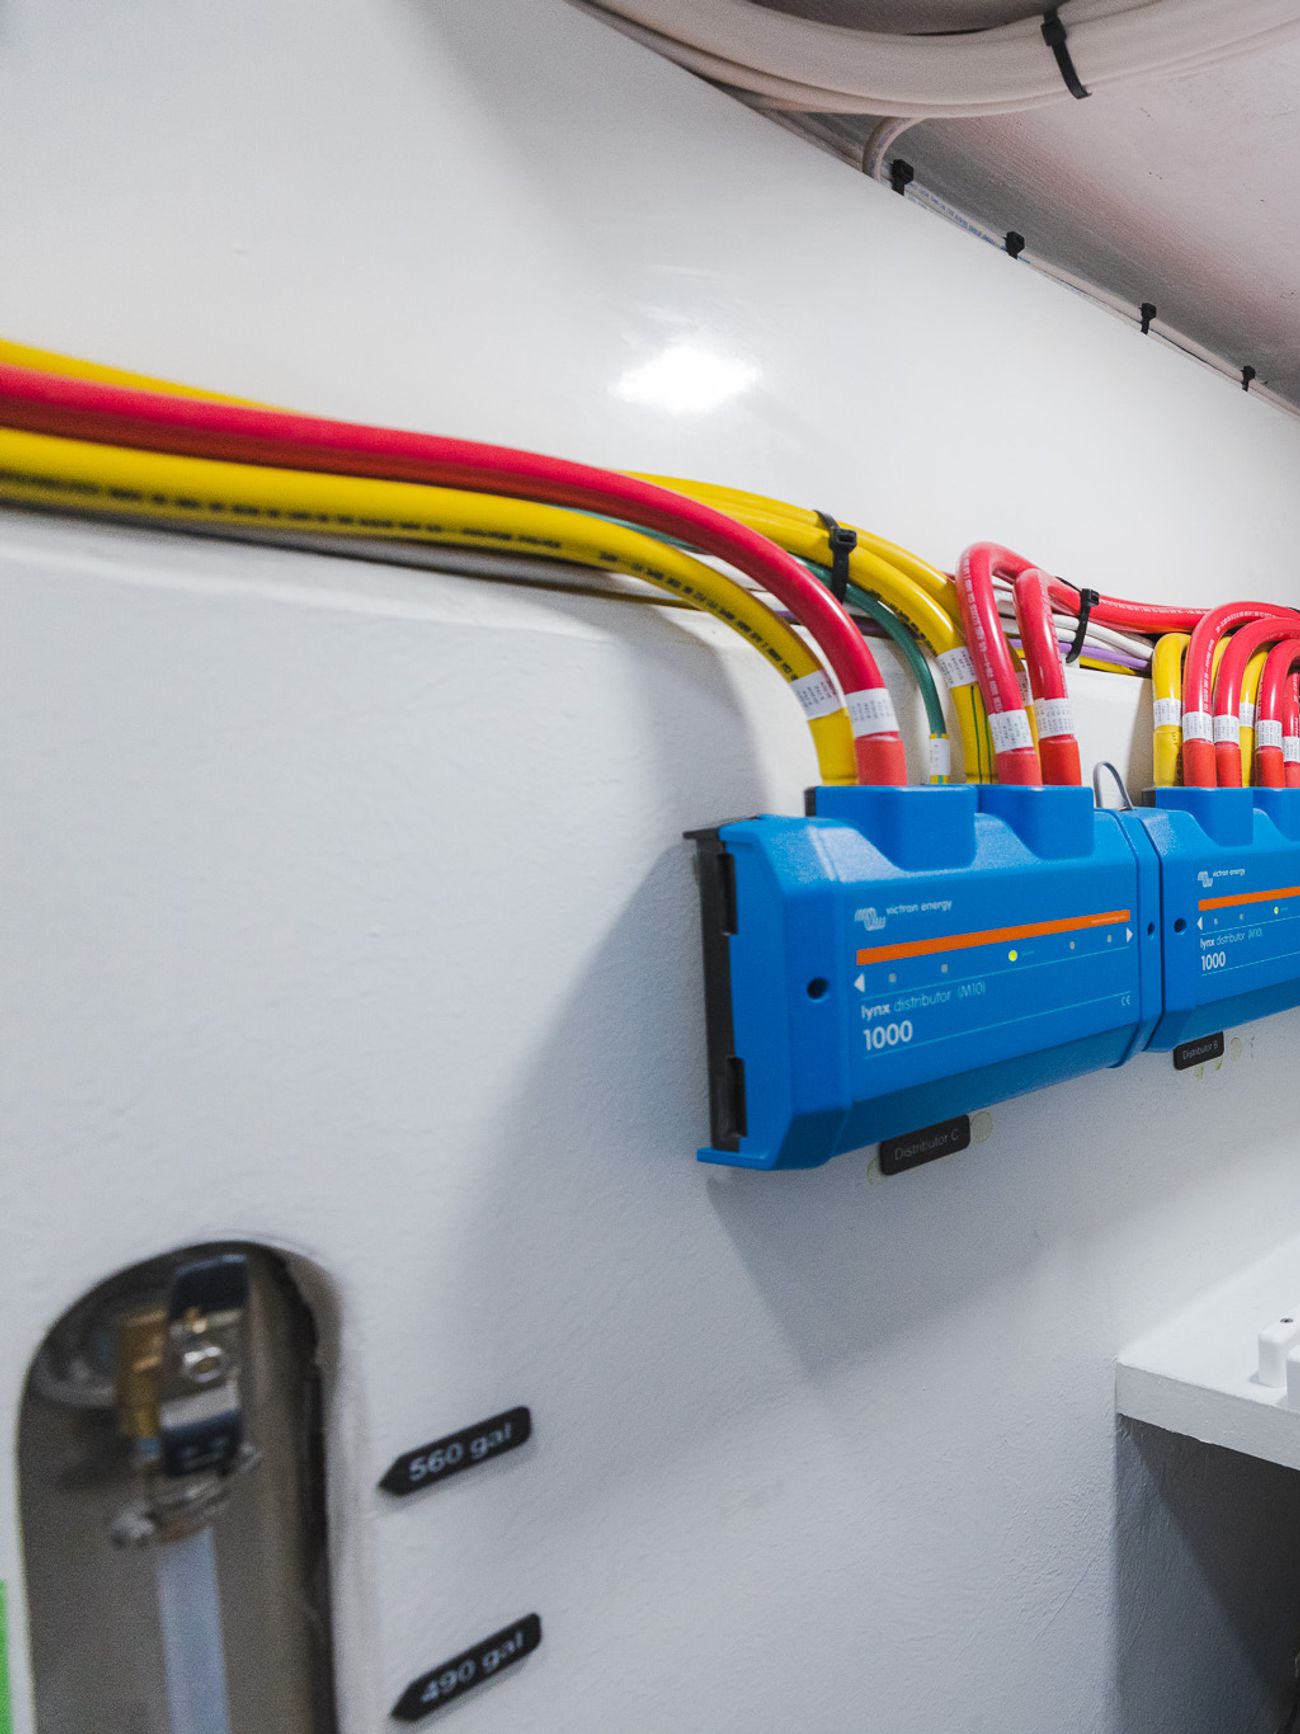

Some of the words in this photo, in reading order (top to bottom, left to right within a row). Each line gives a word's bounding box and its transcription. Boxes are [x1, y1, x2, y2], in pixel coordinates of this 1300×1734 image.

[886, 903, 919, 915] victron
[921, 900, 952, 912] energy
[1200, 938, 1215, 951] lynx
[1216, 932, 1245, 946] distributor
[1201, 951, 1226, 971] 1000
[861, 1003, 890, 1021] lynx
[893, 990, 951, 1012] distributor
[863, 1020, 913, 1051] 1000
[894, 1134, 948, 1160] Distributor
[951, 1128, 960, 1141] C
[409, 1441, 463, 1481] 560
[470, 1421, 512, 1460] gal
[421, 1659, 475, 1704] 490
[482, 1630, 524, 1674] gal
